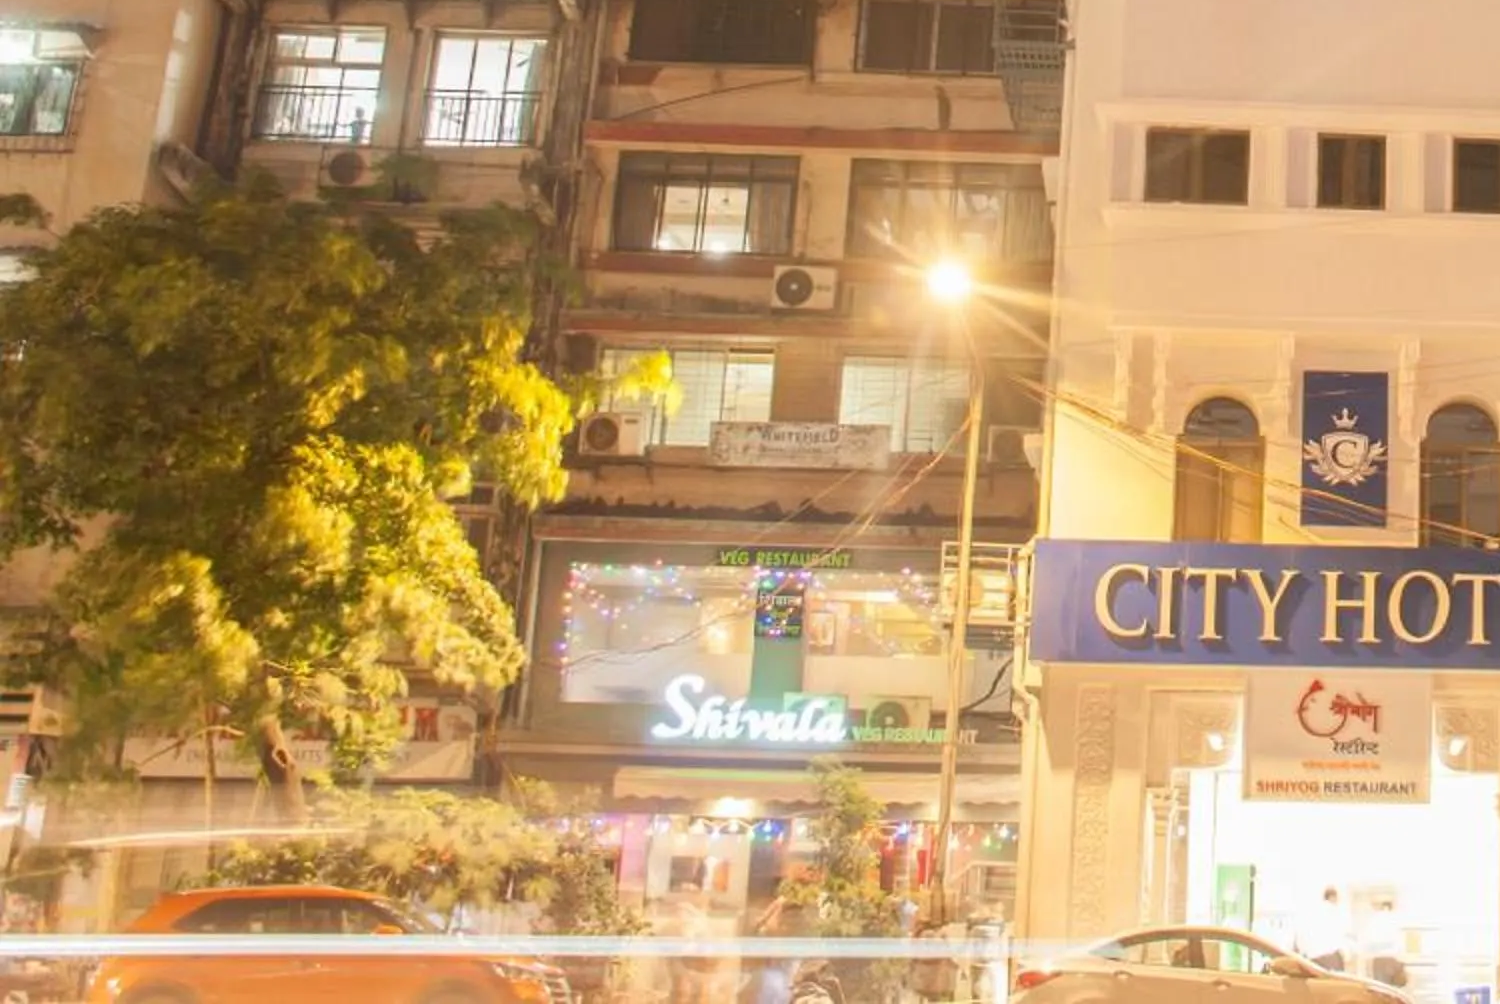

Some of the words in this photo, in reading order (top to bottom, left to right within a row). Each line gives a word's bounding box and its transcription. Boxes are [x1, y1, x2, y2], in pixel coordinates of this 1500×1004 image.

[1331, 439, 1358, 469] C
[719, 551, 750, 566] VEG
[755, 550, 851, 567] RESTAURANT
[1095, 563, 1299, 641] CITY
[651, 673, 847, 743] Shivala
[851, 726, 882, 742] VEG
[884, 726, 979, 745] RESTAURNT
[1256, 780, 1320, 794] SHRIYOG
[1323, 781, 1418, 795] RESTAURANT
